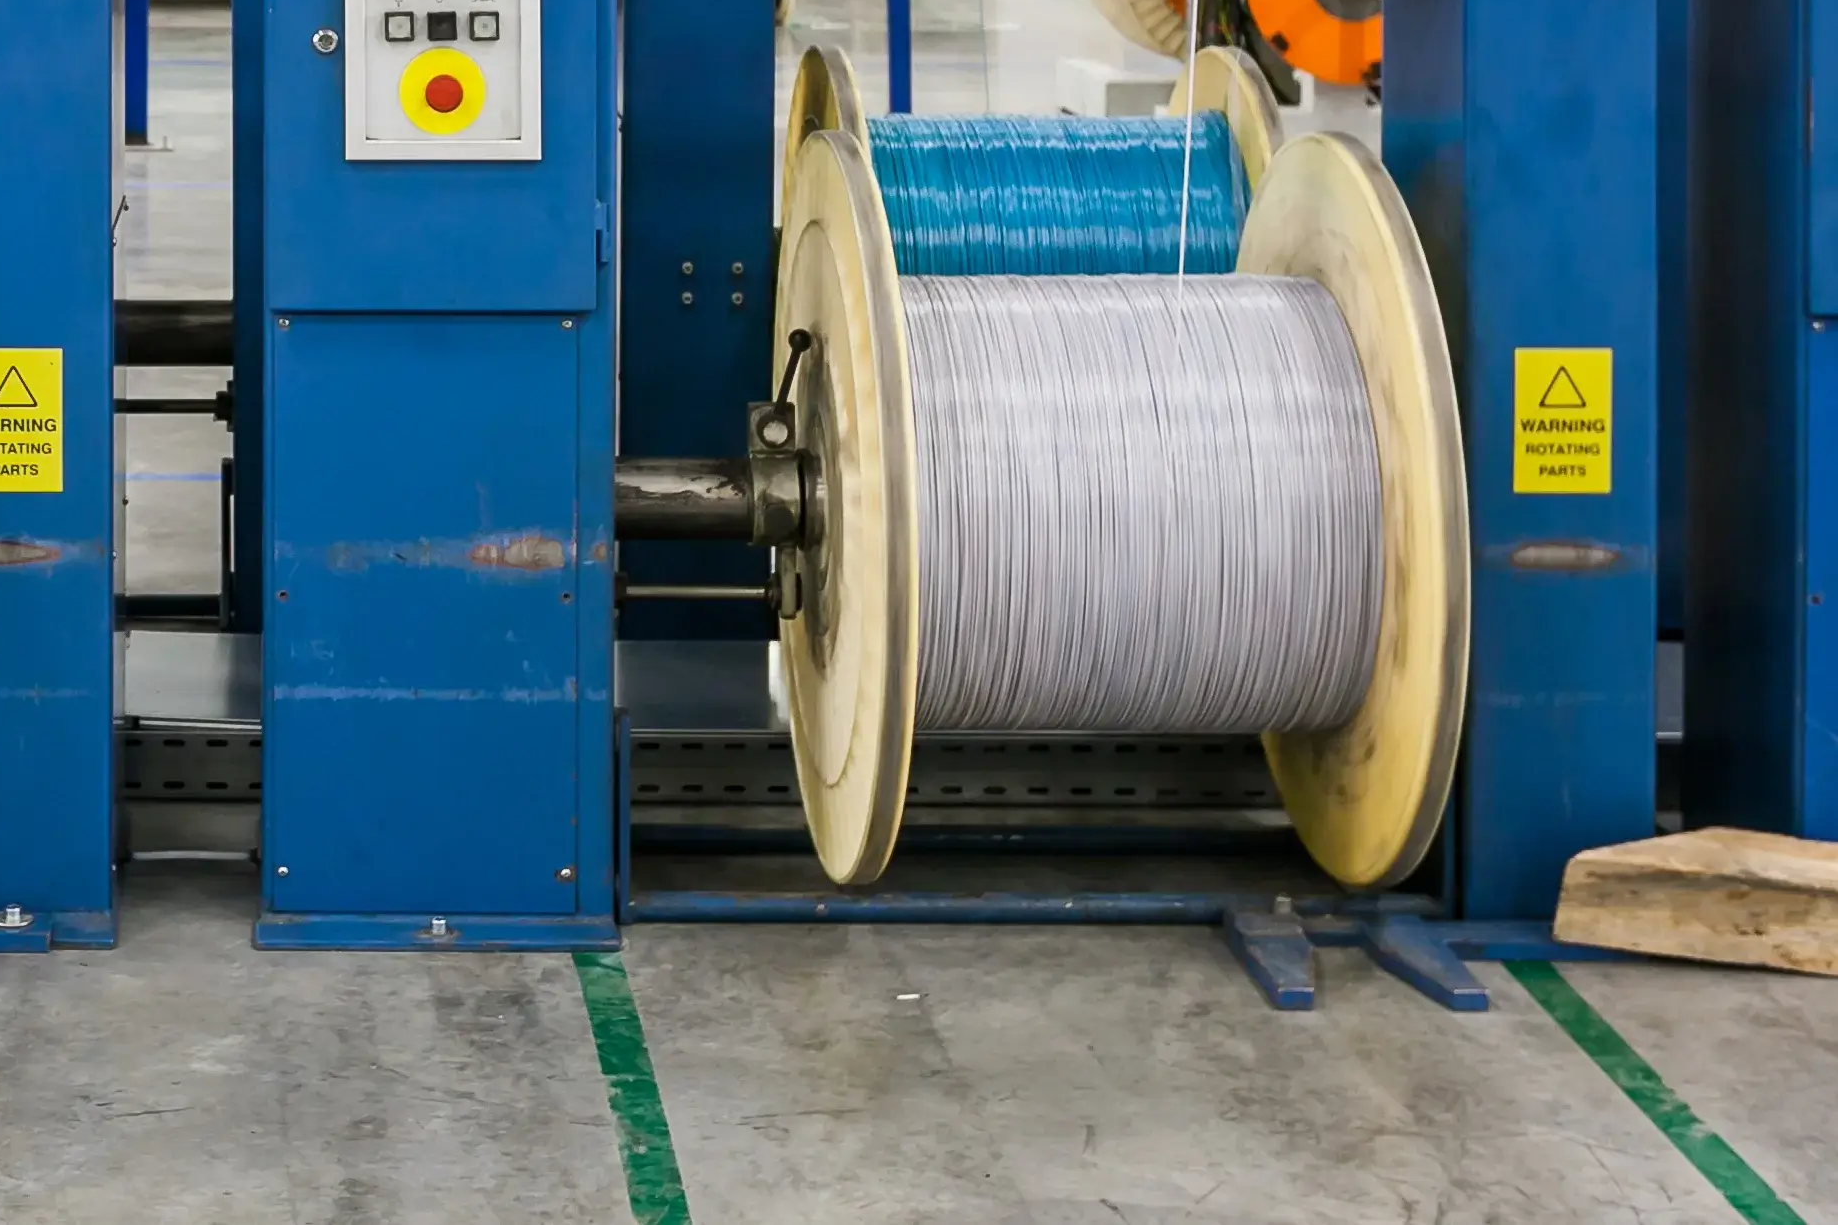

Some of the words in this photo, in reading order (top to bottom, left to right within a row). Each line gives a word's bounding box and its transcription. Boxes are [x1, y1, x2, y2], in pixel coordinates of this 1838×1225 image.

[1520, 418, 1606, 433] WARNING
[1525, 443, 1600, 455] ROTATING
[1538, 465, 1587, 476] PARTS
